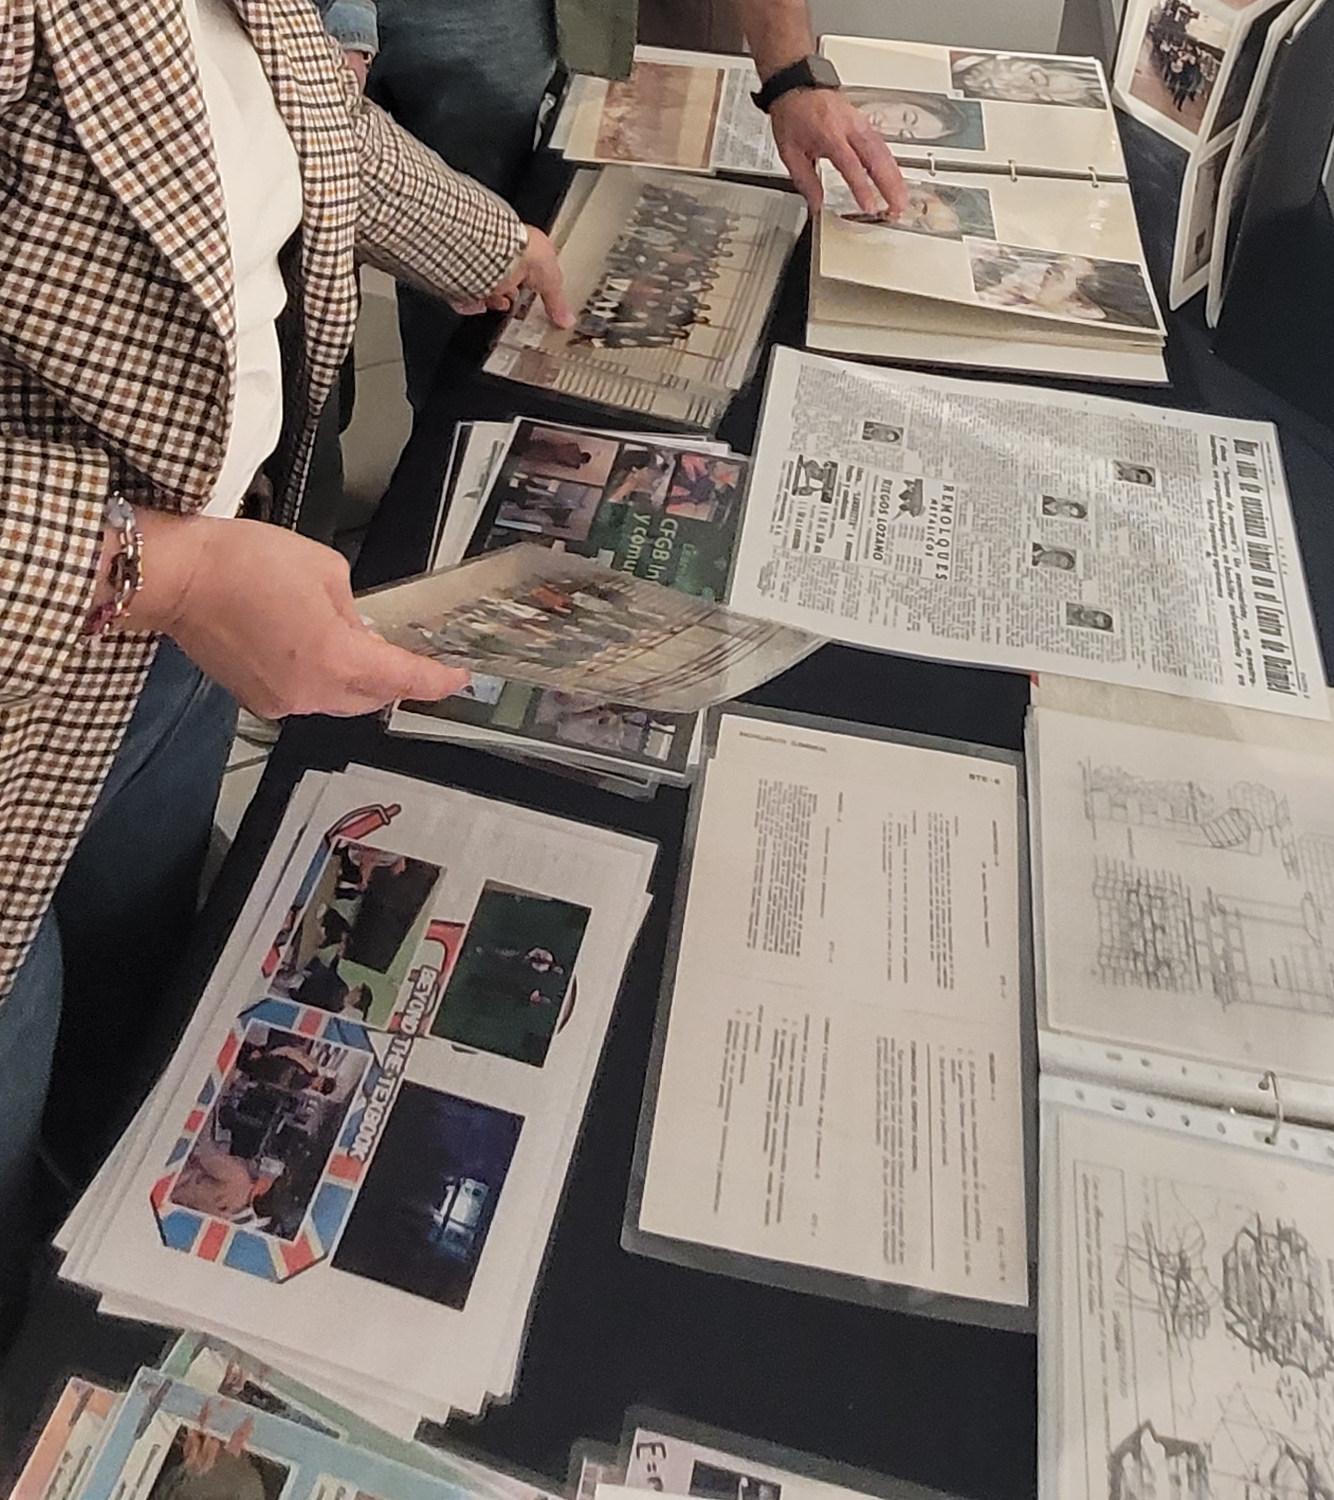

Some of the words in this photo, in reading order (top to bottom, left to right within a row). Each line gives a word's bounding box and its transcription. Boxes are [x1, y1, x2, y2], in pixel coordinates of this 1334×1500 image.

[877, 478, 892, 515] RIEGOS
[1238, 481, 1263, 494] de
[620, 527, 647, 575] comu
[651, 518, 678, 560] CFGB
[872, 518, 886, 561] LOZANO
[932, 483, 953, 581] REMOLQUES
[645, 564, 664, 585] In
[1255, 605, 1287, 637] Centro
[1260, 638, 1289, 653] de
[1262, 654, 1296, 695] Daimiel
[399, 966, 438, 1035] BEYOND
[384, 1036, 412, 1074] THE
[350, 1075, 395, 1161] TEXBOOK
